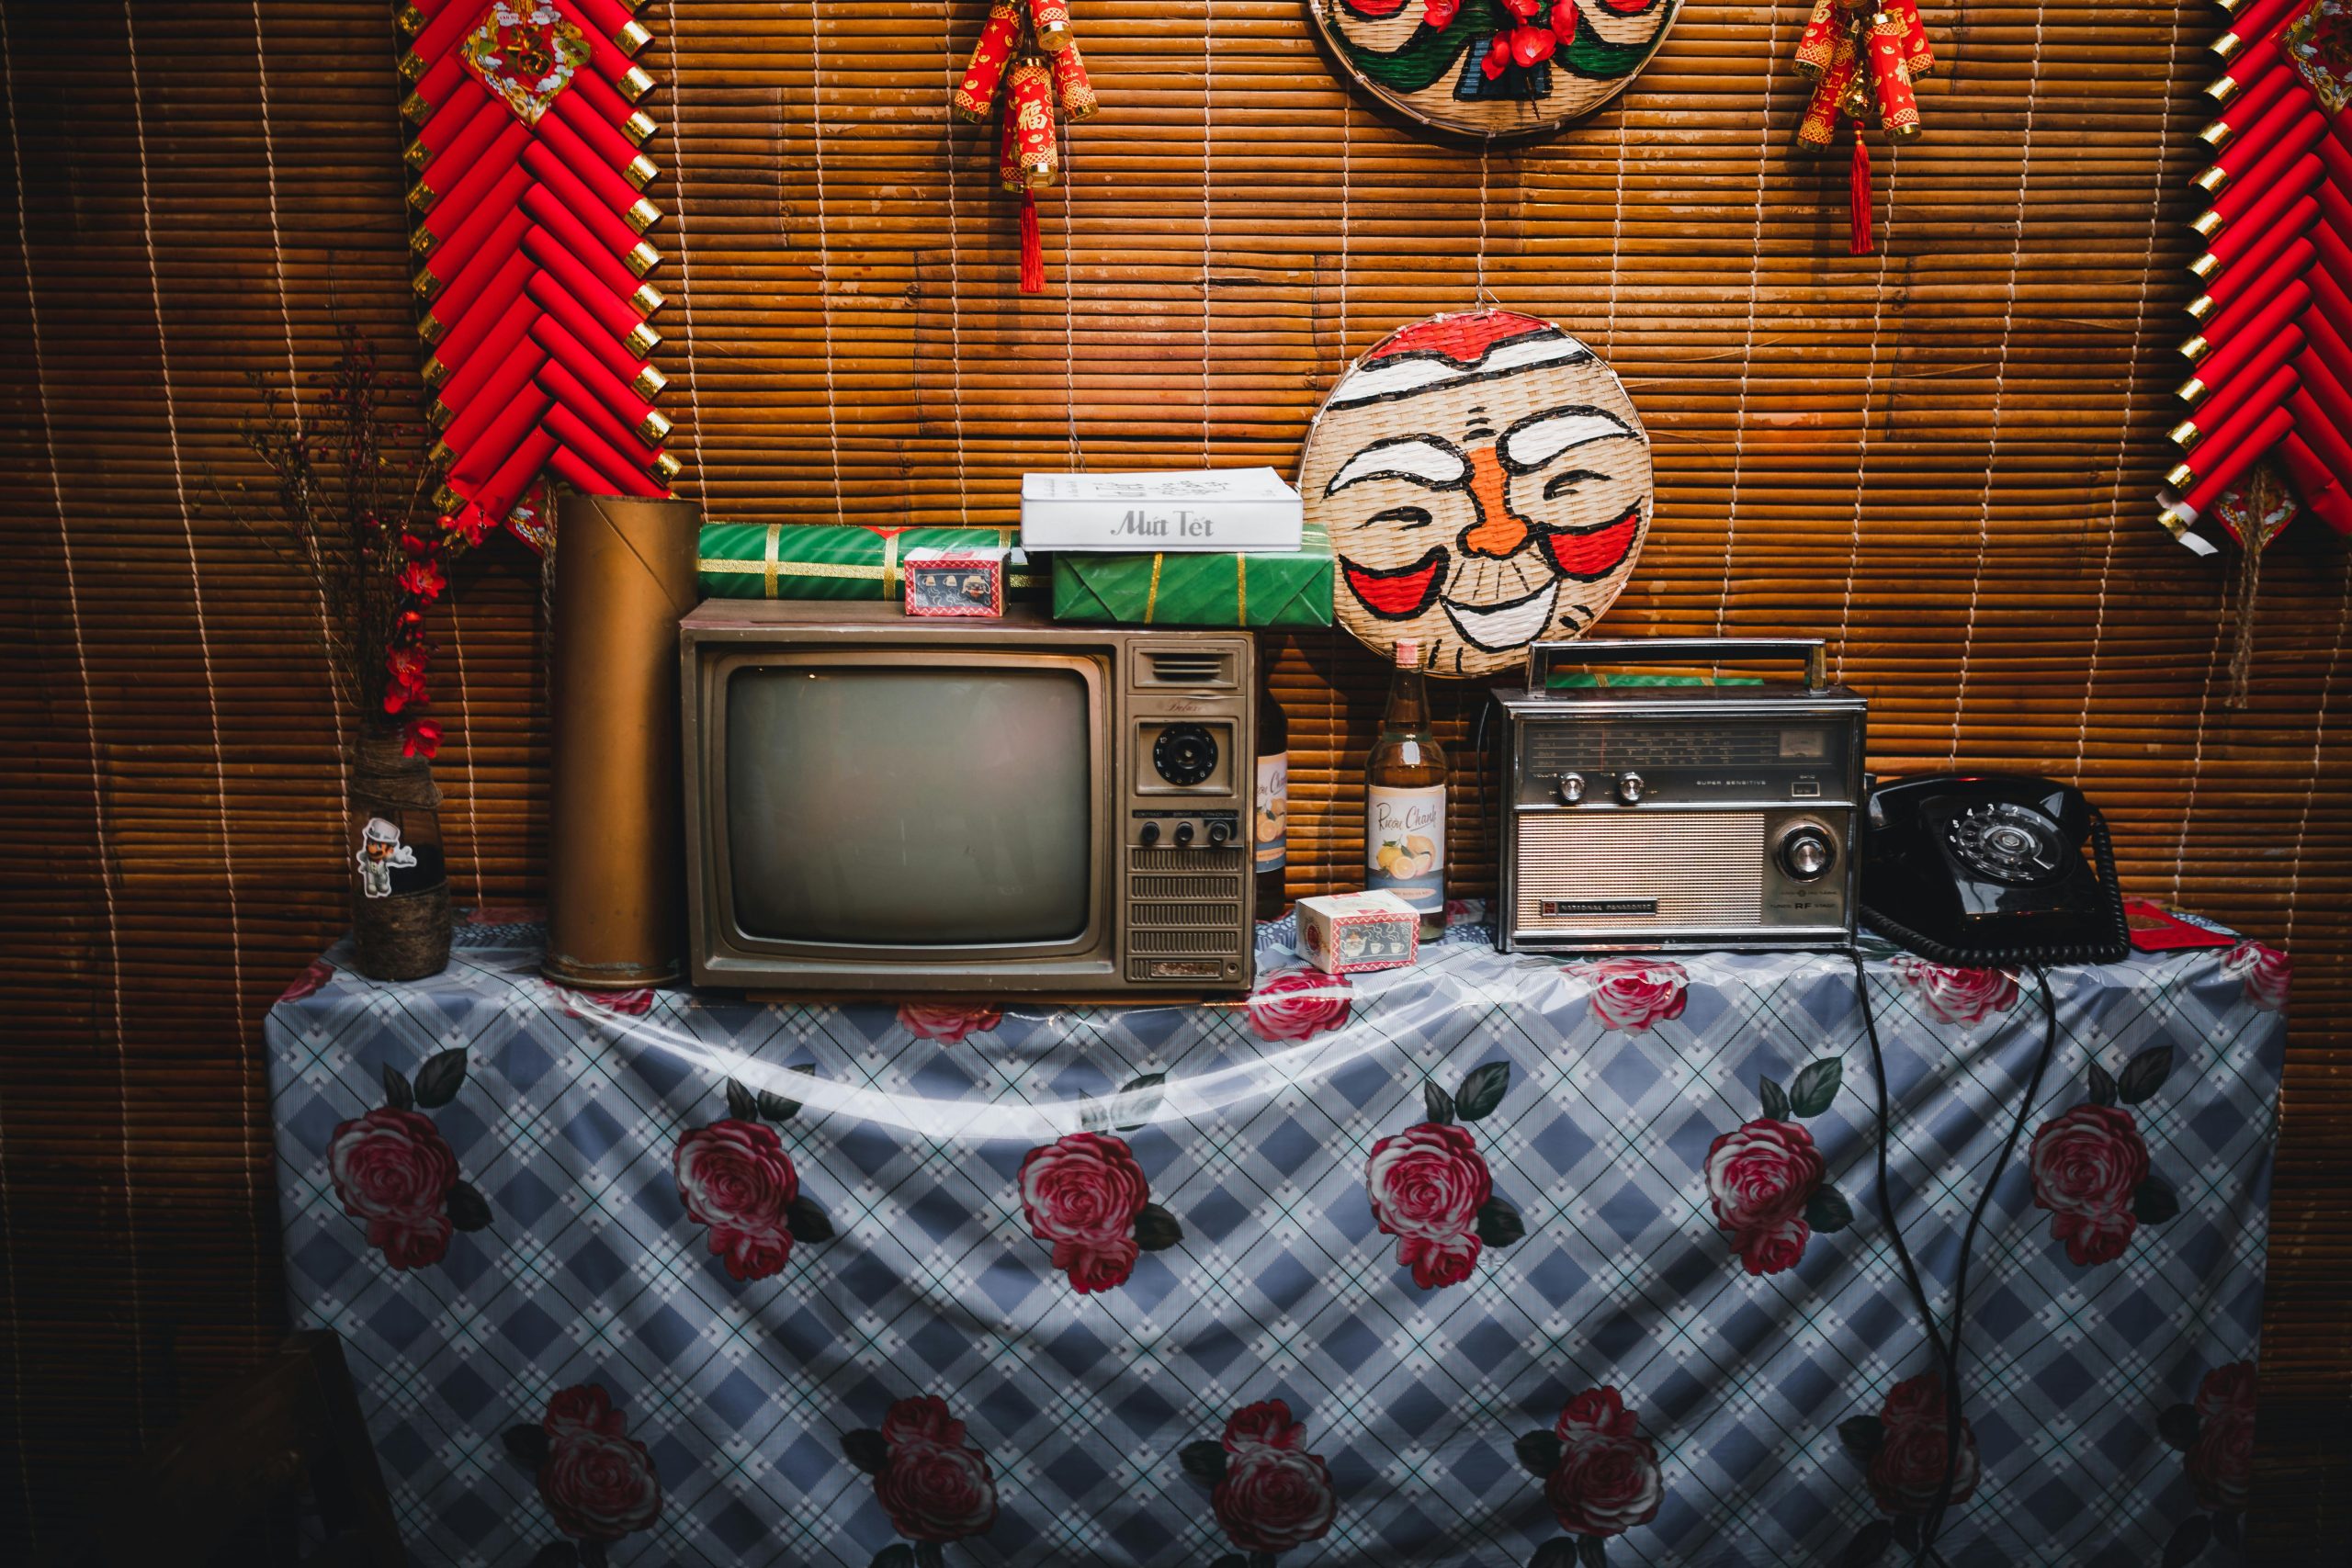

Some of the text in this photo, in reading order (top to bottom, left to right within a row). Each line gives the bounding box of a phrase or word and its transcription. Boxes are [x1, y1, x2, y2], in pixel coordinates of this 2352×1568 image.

[1018, 98, 1048, 131] 福
[1172, 510, 1214, 536] Tết
[1406, 804, 1437, 829] Chanh
